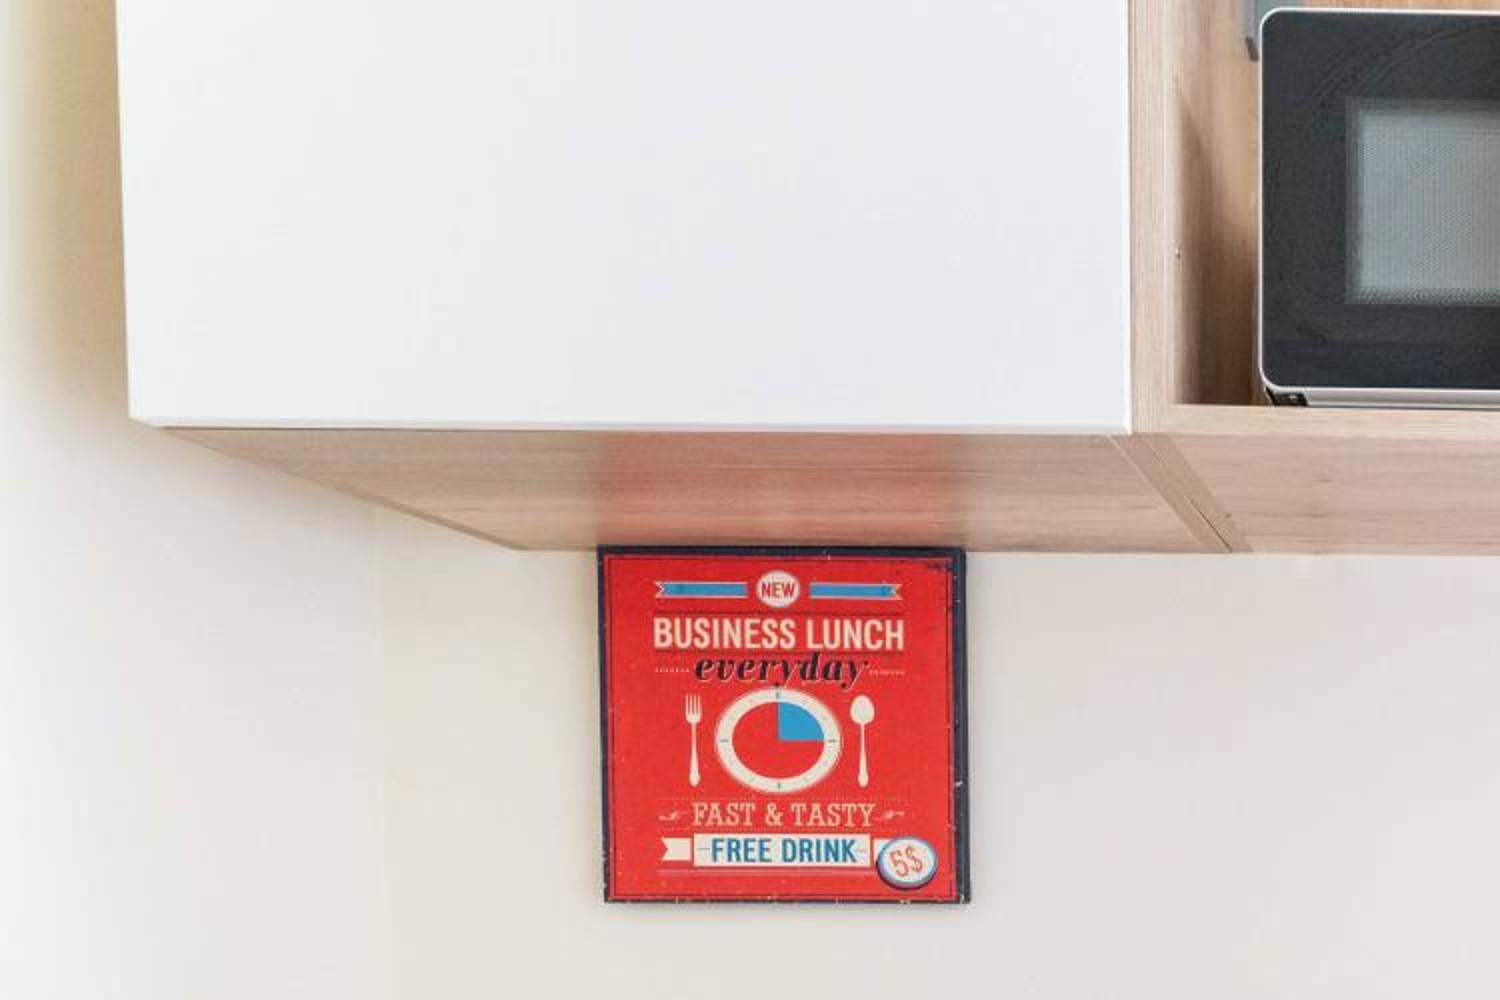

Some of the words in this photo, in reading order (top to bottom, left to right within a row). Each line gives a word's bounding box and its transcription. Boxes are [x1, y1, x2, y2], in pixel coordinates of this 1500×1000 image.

[760, 581, 795, 599] NEW
[654, 618, 796, 649] BUSINESS
[807, 619, 904, 651] LUNCH
[695, 653, 868, 689] everyday
[692, 803, 756, 827] FAST
[765, 803, 783, 826] &
[791, 803, 876, 827] TASTY
[711, 839, 772, 863] FREE
[781, 839, 856, 864] DRINK
[890, 845, 925, 879] 5$
